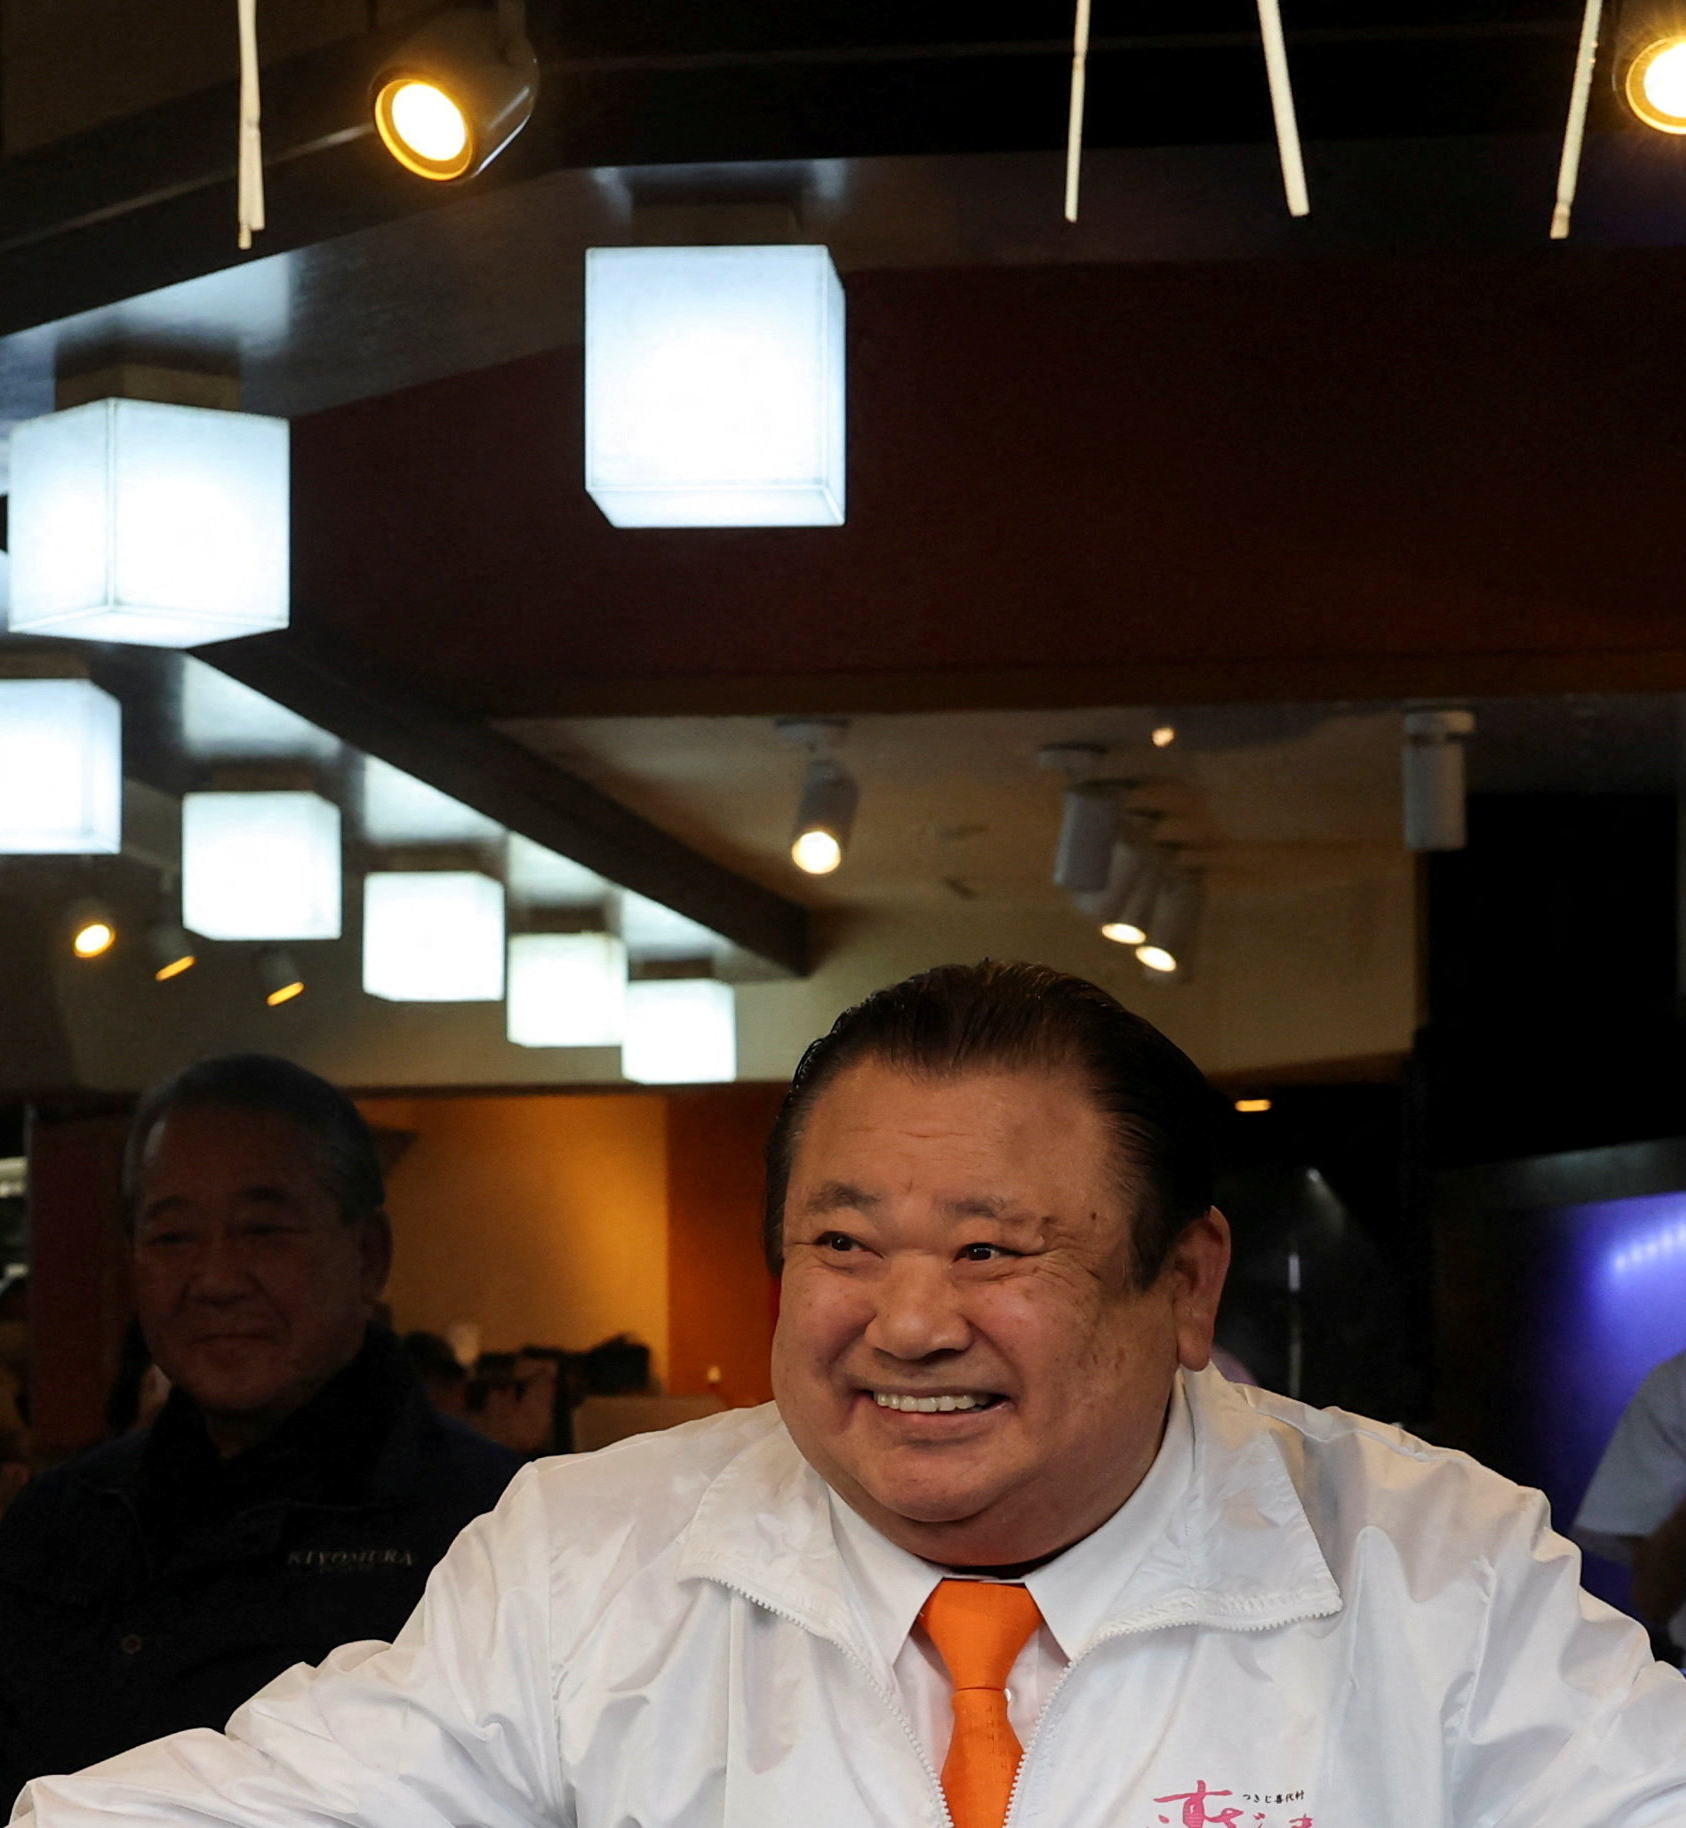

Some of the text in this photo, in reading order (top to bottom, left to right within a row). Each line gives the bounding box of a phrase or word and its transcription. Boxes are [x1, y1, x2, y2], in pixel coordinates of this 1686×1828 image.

[287, 1549, 414, 1567] KIYOMURA
[1242, 1790, 1305, 1804] つきじ喜代村
